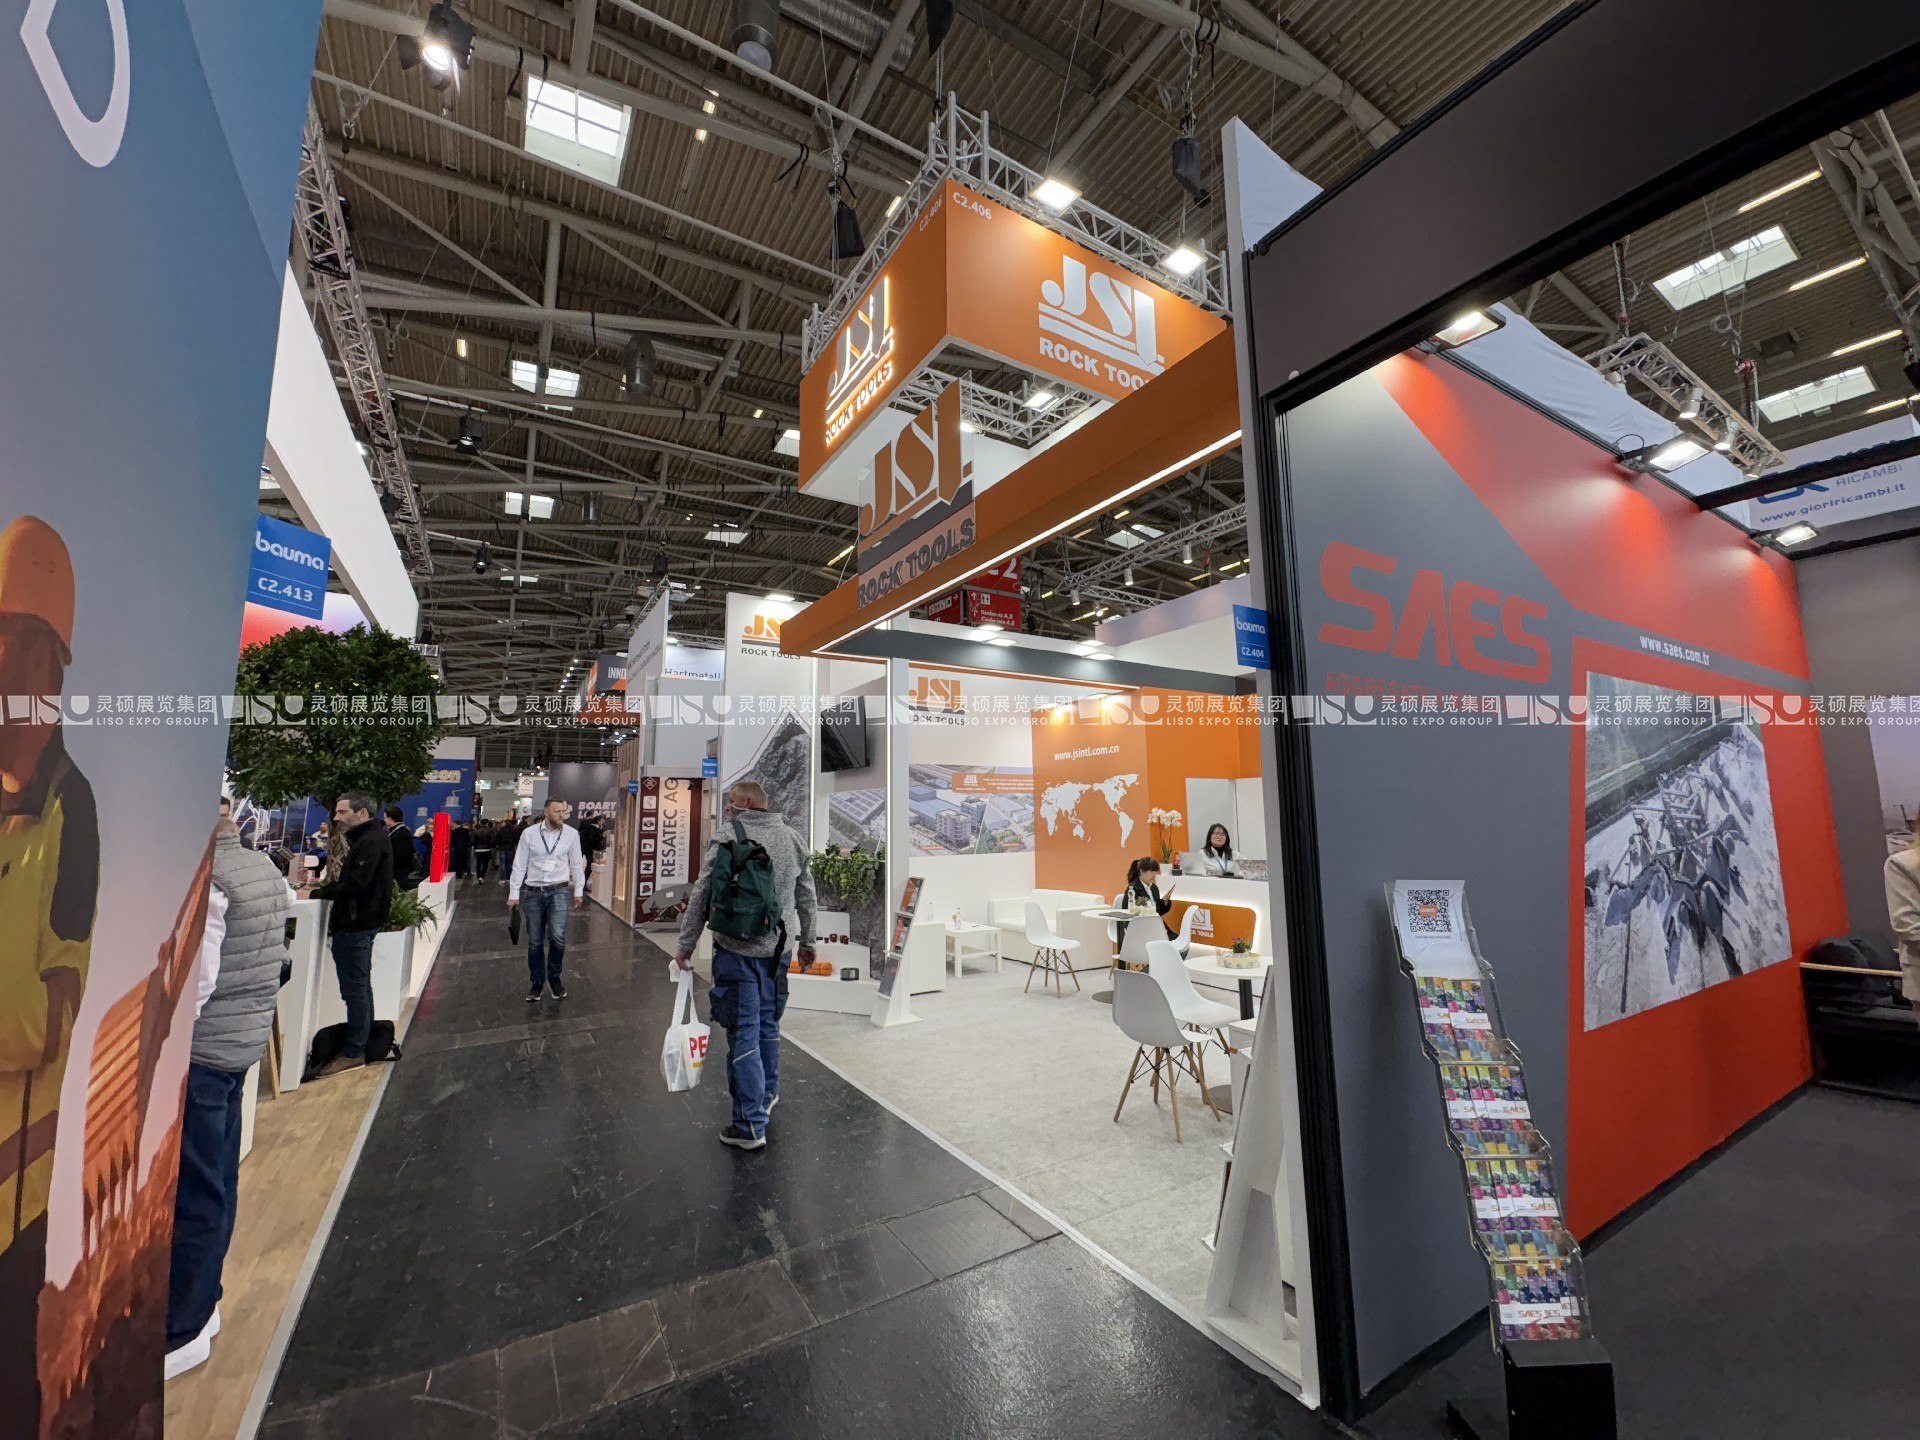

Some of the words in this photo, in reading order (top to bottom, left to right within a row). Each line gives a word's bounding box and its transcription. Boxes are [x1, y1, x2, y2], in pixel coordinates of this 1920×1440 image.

[920, 195, 943, 231] C2.406
[953, 192, 992, 219] C2.406
[1039, 337, 1100, 377] ROCK
[1104, 362, 1150, 390] TOO
[825, 403, 853, 446] ROCK
[854, 360, 892, 412] TOOLS
[1836, 464, 1903, 488] RICAMBI
[1760, 483, 1906, 523] www.gioriricambi.it
[255, 530, 325, 571] bauma
[857, 552, 905, 607] ROCK
[905, 516, 976, 580] TOOLS
[258, 577, 313, 602] C2.413
[1235, 617, 1266, 635] bauma
[1318, 541, 1552, 684] SAES
[741, 647, 768, 657] ROCK
[1241, 646, 1265, 659] C2.404
[1639, 635, 1710, 666] www.saes.com.tr
[1053, 745, 1120, 761] www.jsintl.com.cn
[578, 801, 616, 810] BOART
[664, 777, 679, 803] AG
[661, 809, 678, 878] RESATEC
[678, 808, 686, 877] SWITZERLAND
